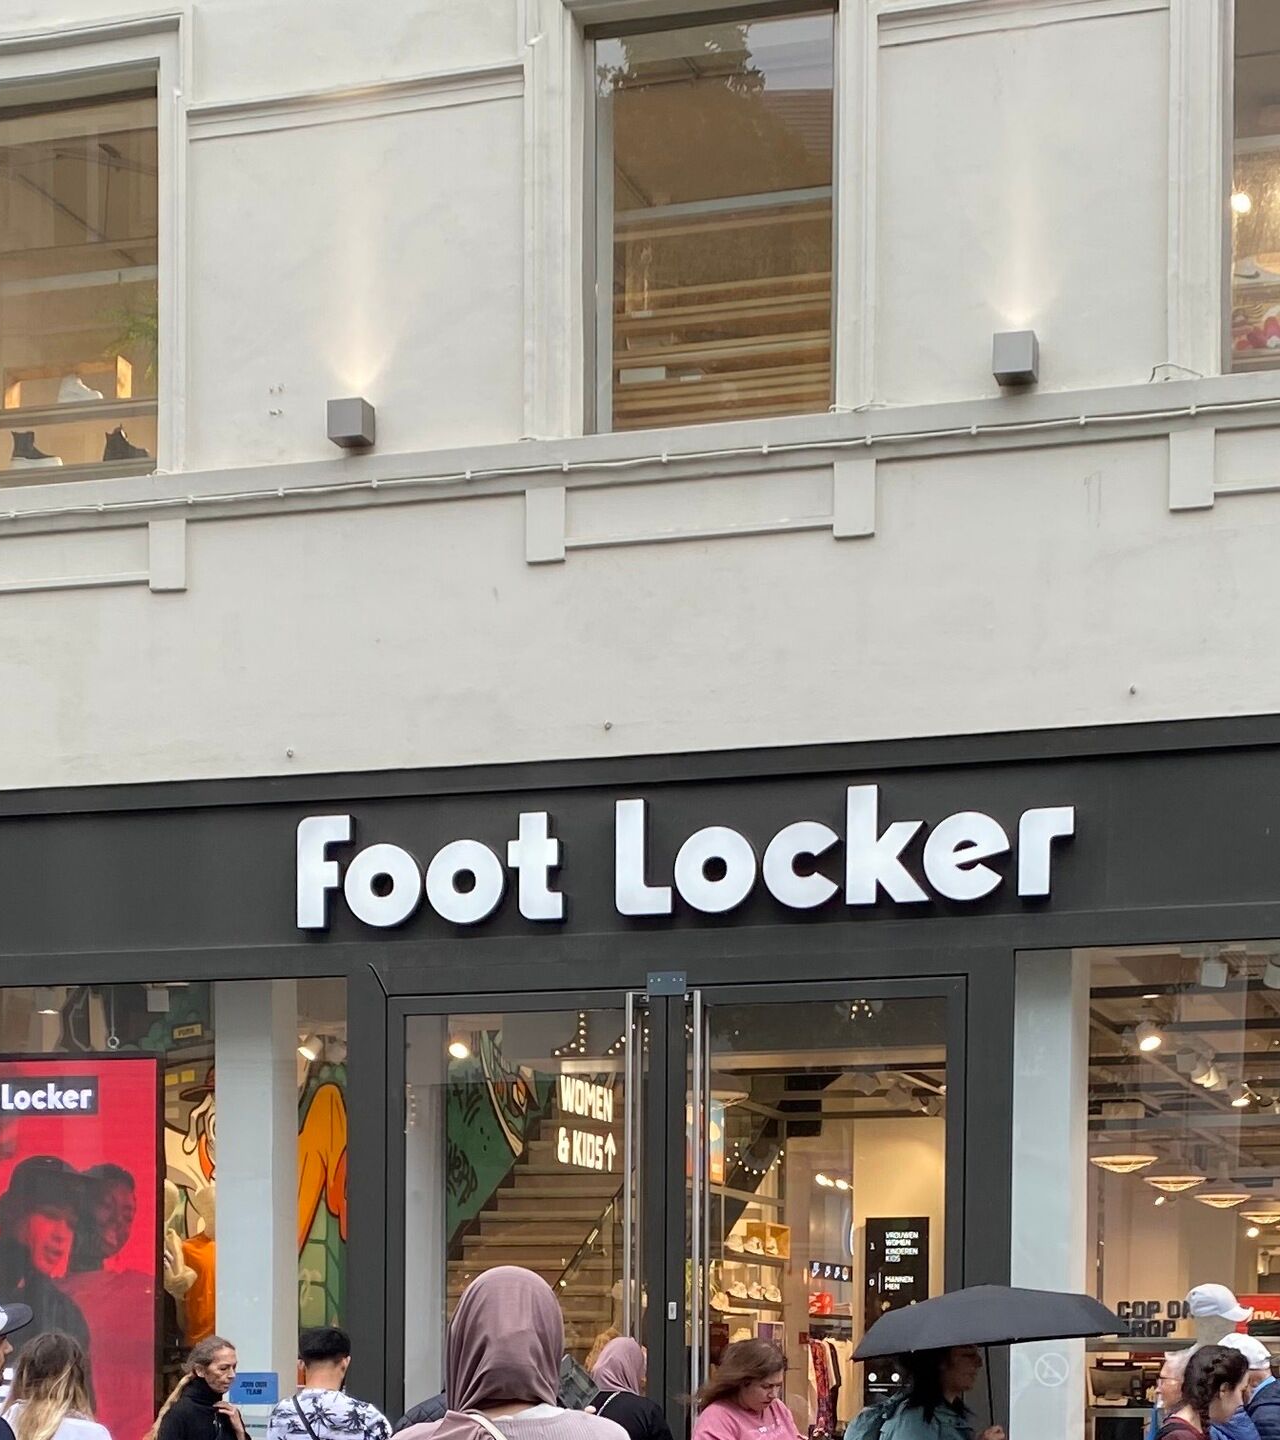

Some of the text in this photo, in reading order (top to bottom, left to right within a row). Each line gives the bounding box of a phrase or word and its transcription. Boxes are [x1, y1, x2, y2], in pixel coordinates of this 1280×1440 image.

[296, 783, 1077, 929] Foot Locker
[1, 1083, 92, 1110] Locker
[560, 1074, 613, 1123] WOMEN
[557, 1126, 604, 1170] & KIDS
[1117, 1301, 1161, 1319] COP
[1122, 1320, 1176, 1337] ROP
